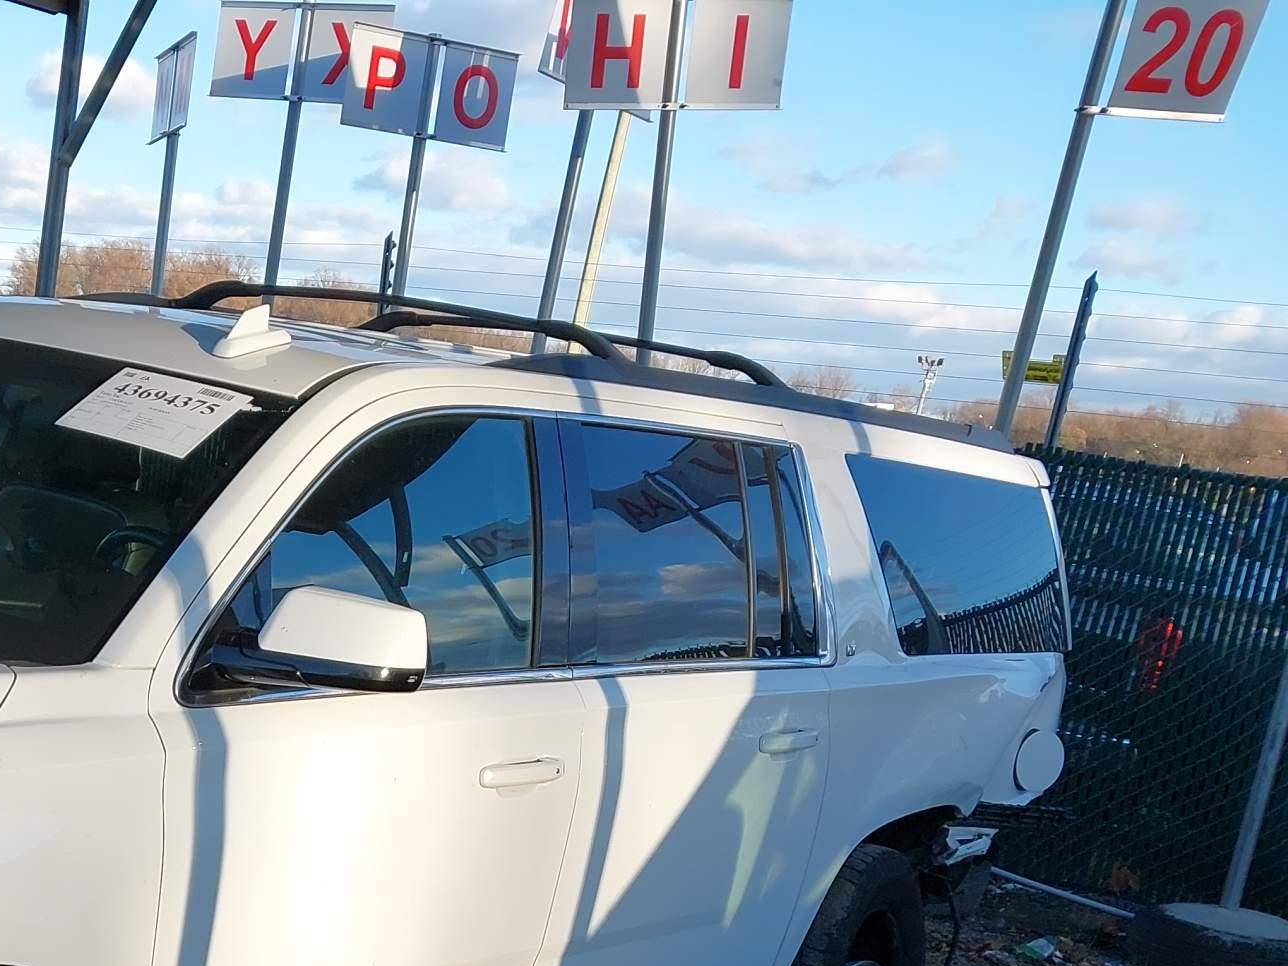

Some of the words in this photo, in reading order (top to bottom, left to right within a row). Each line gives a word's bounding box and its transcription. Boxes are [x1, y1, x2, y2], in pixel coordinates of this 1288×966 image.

[234, 19, 278, 81] Y
[363, 45, 406, 110] P
[590, 13, 646, 88] H
[728, 15, 750, 89] I
[1124, 6, 1244, 97] 20
[113, 382, 221, 415] 43694375
